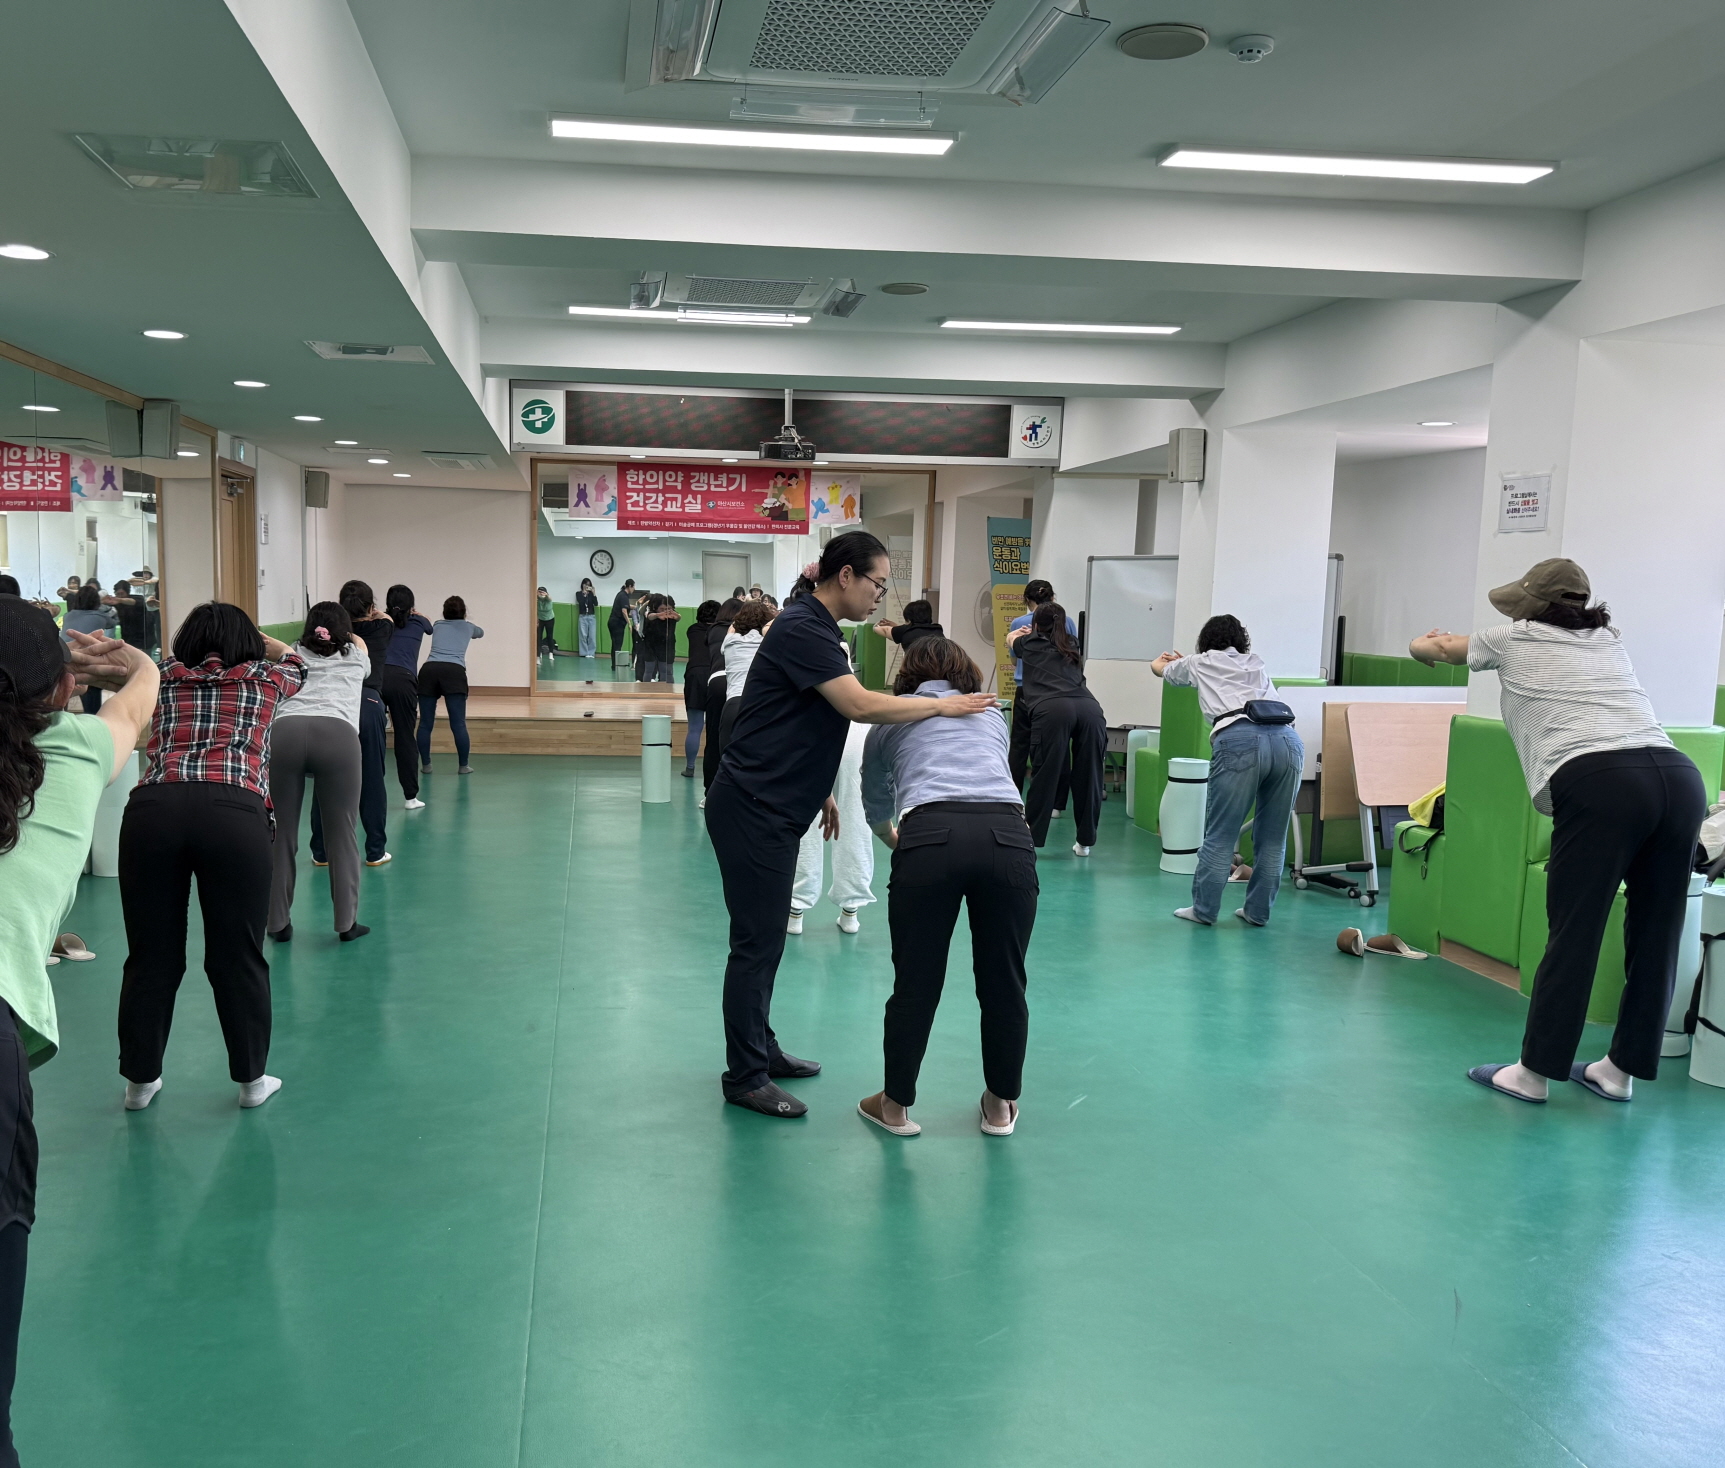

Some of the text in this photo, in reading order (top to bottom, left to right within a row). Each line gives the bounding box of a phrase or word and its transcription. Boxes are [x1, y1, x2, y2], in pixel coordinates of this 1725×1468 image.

[626, 469, 747, 492] 한의약 갱년기
[626, 492, 702, 513] 건강교실
[991, 535, 1004, 546] 비만
[1005, 536, 1024, 547] 예방을
[992, 546, 1021, 560] 운동과
[993, 560, 1030, 575] 식이요법
